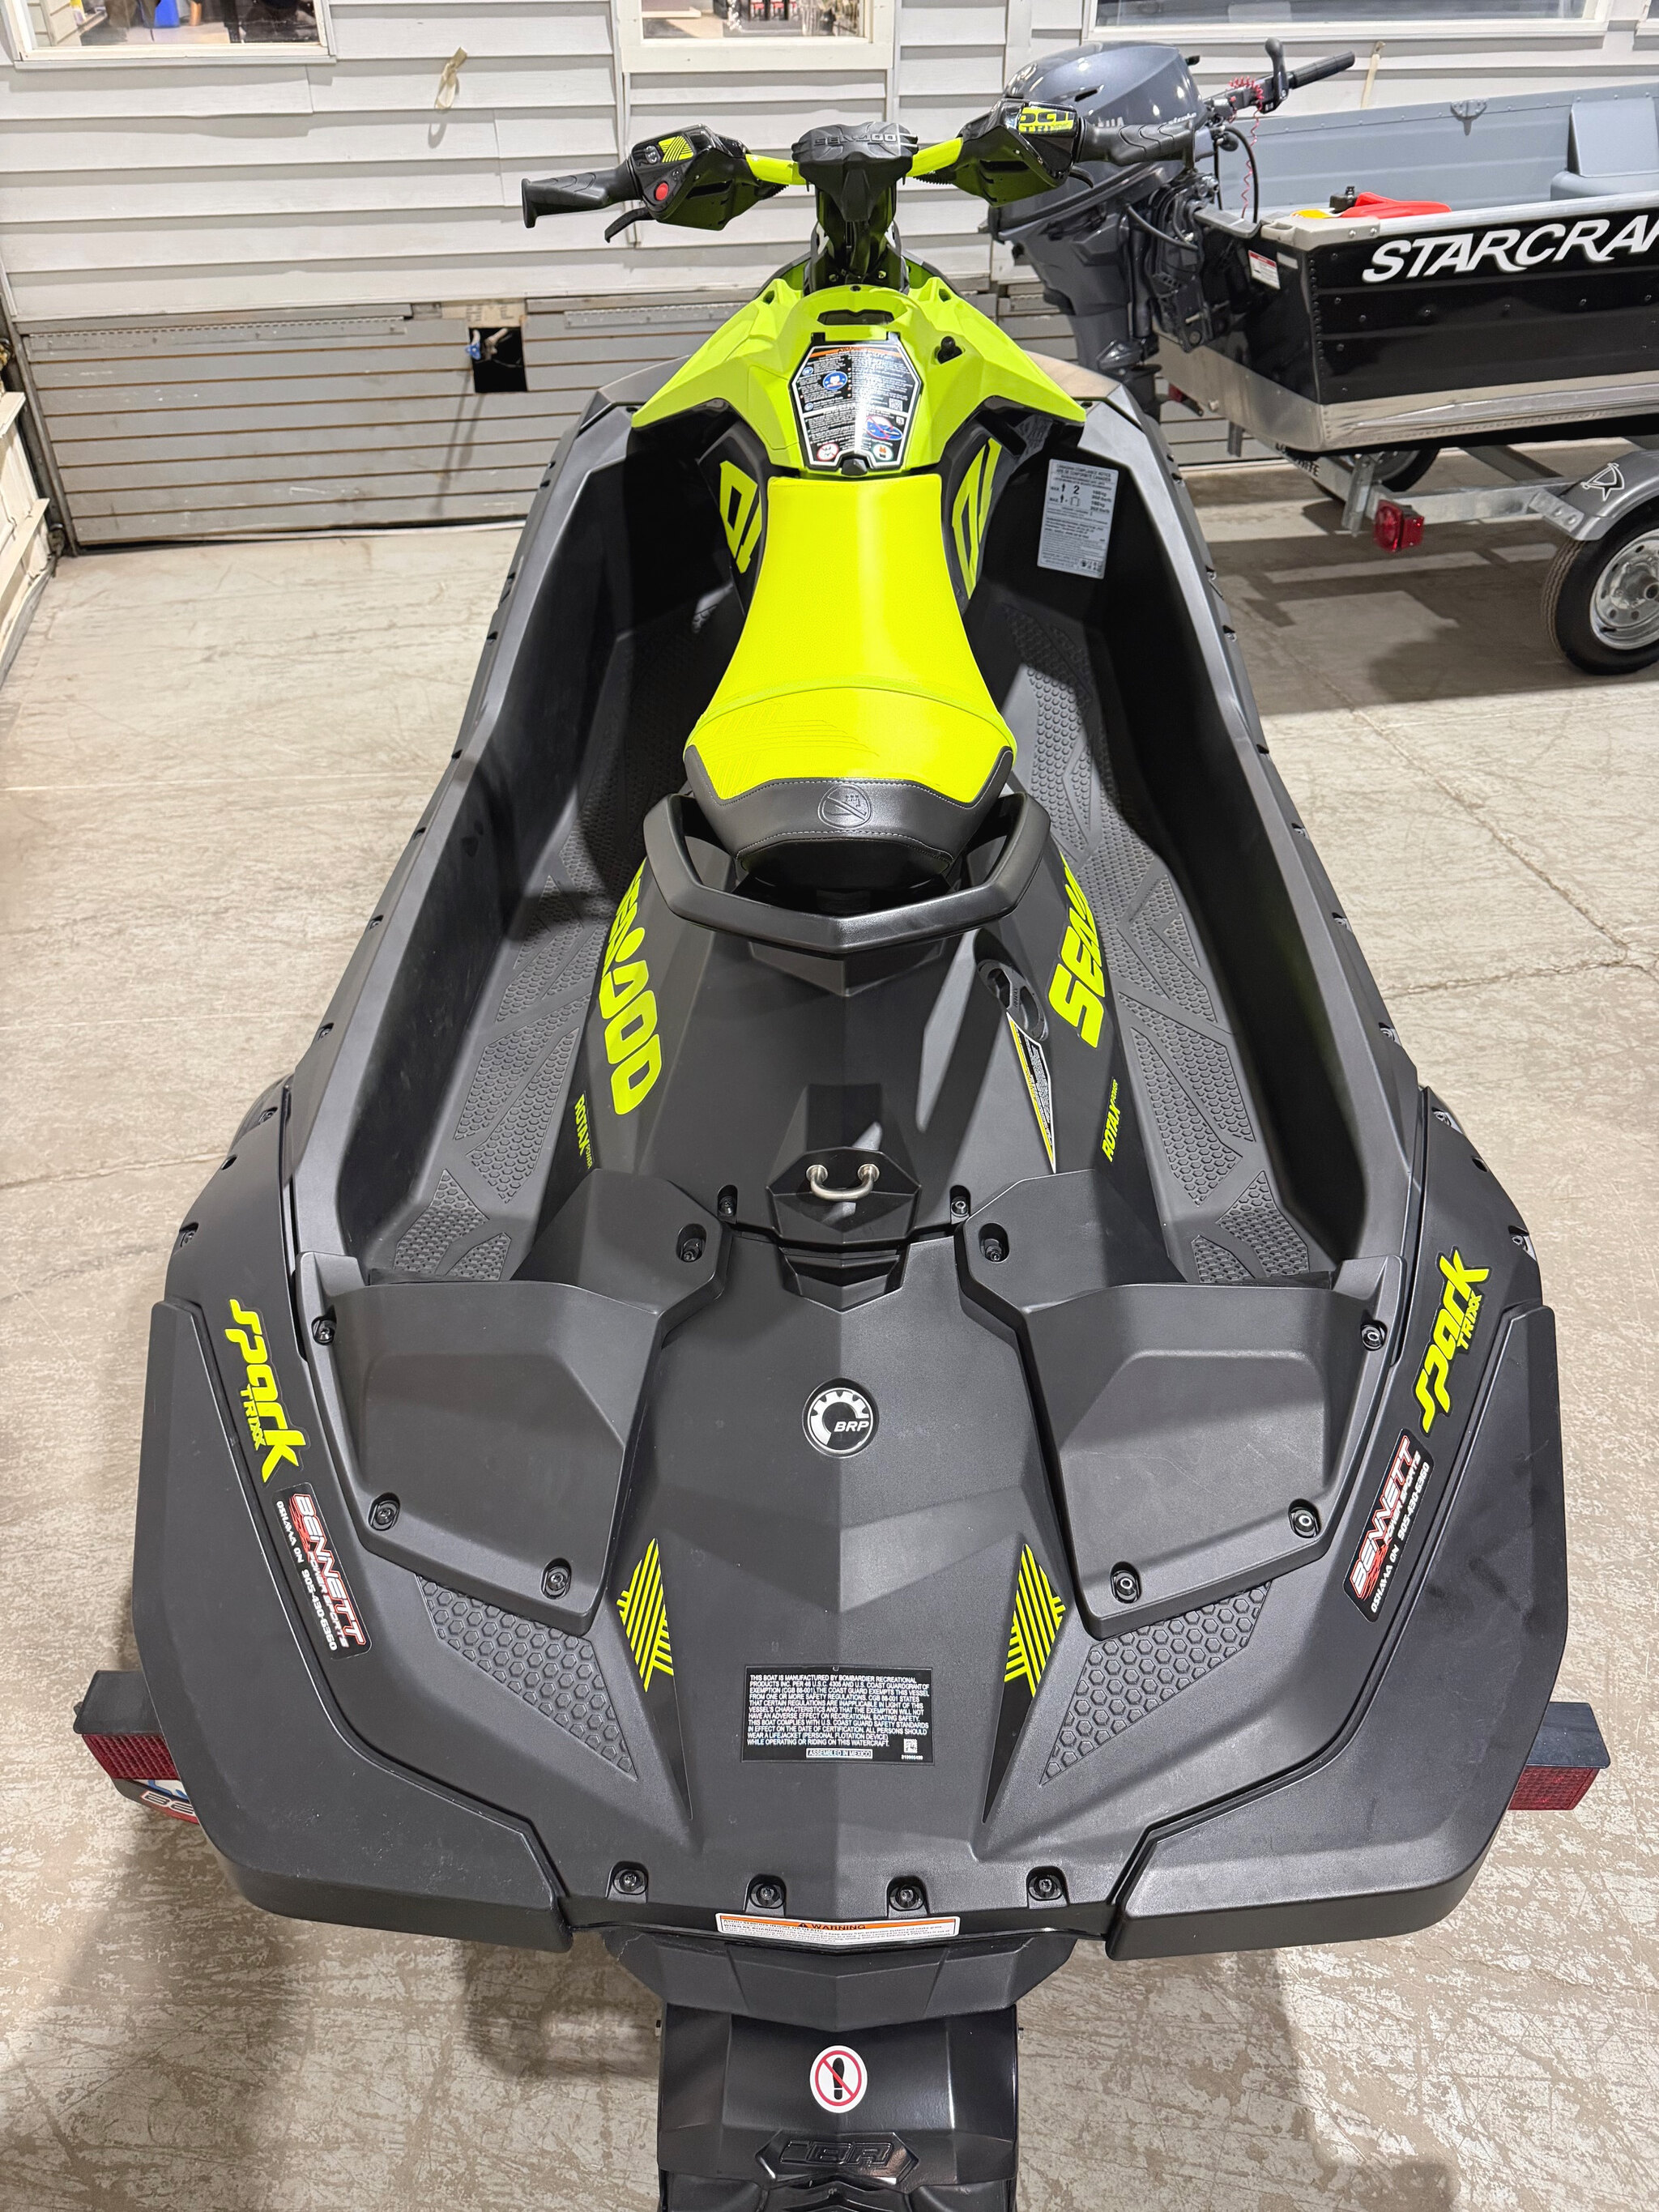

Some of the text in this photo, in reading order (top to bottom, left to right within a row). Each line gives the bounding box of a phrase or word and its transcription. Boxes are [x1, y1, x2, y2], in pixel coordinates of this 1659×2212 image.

[1073, 485, 1080, 494] 2
[574, 1093, 586, 1157] ROTAX
[1102, 1105, 1121, 1162] ROTAX
[1456, 1290, 1482, 1350] TRIXX
[240, 1383, 267, 1451] TRIXX
[834, 1421, 870, 1432] BRP
[276, 1501, 297, 1547] OSHAWA
[293, 1547, 305, 1563] ON
[1350, 1435, 1412, 1598] BENNETT
[294, 1494, 366, 1645] BENNETT
[1371, 1565, 1393, 1613] OSHAWA
[1389, 1545, 1400, 1563] ON
